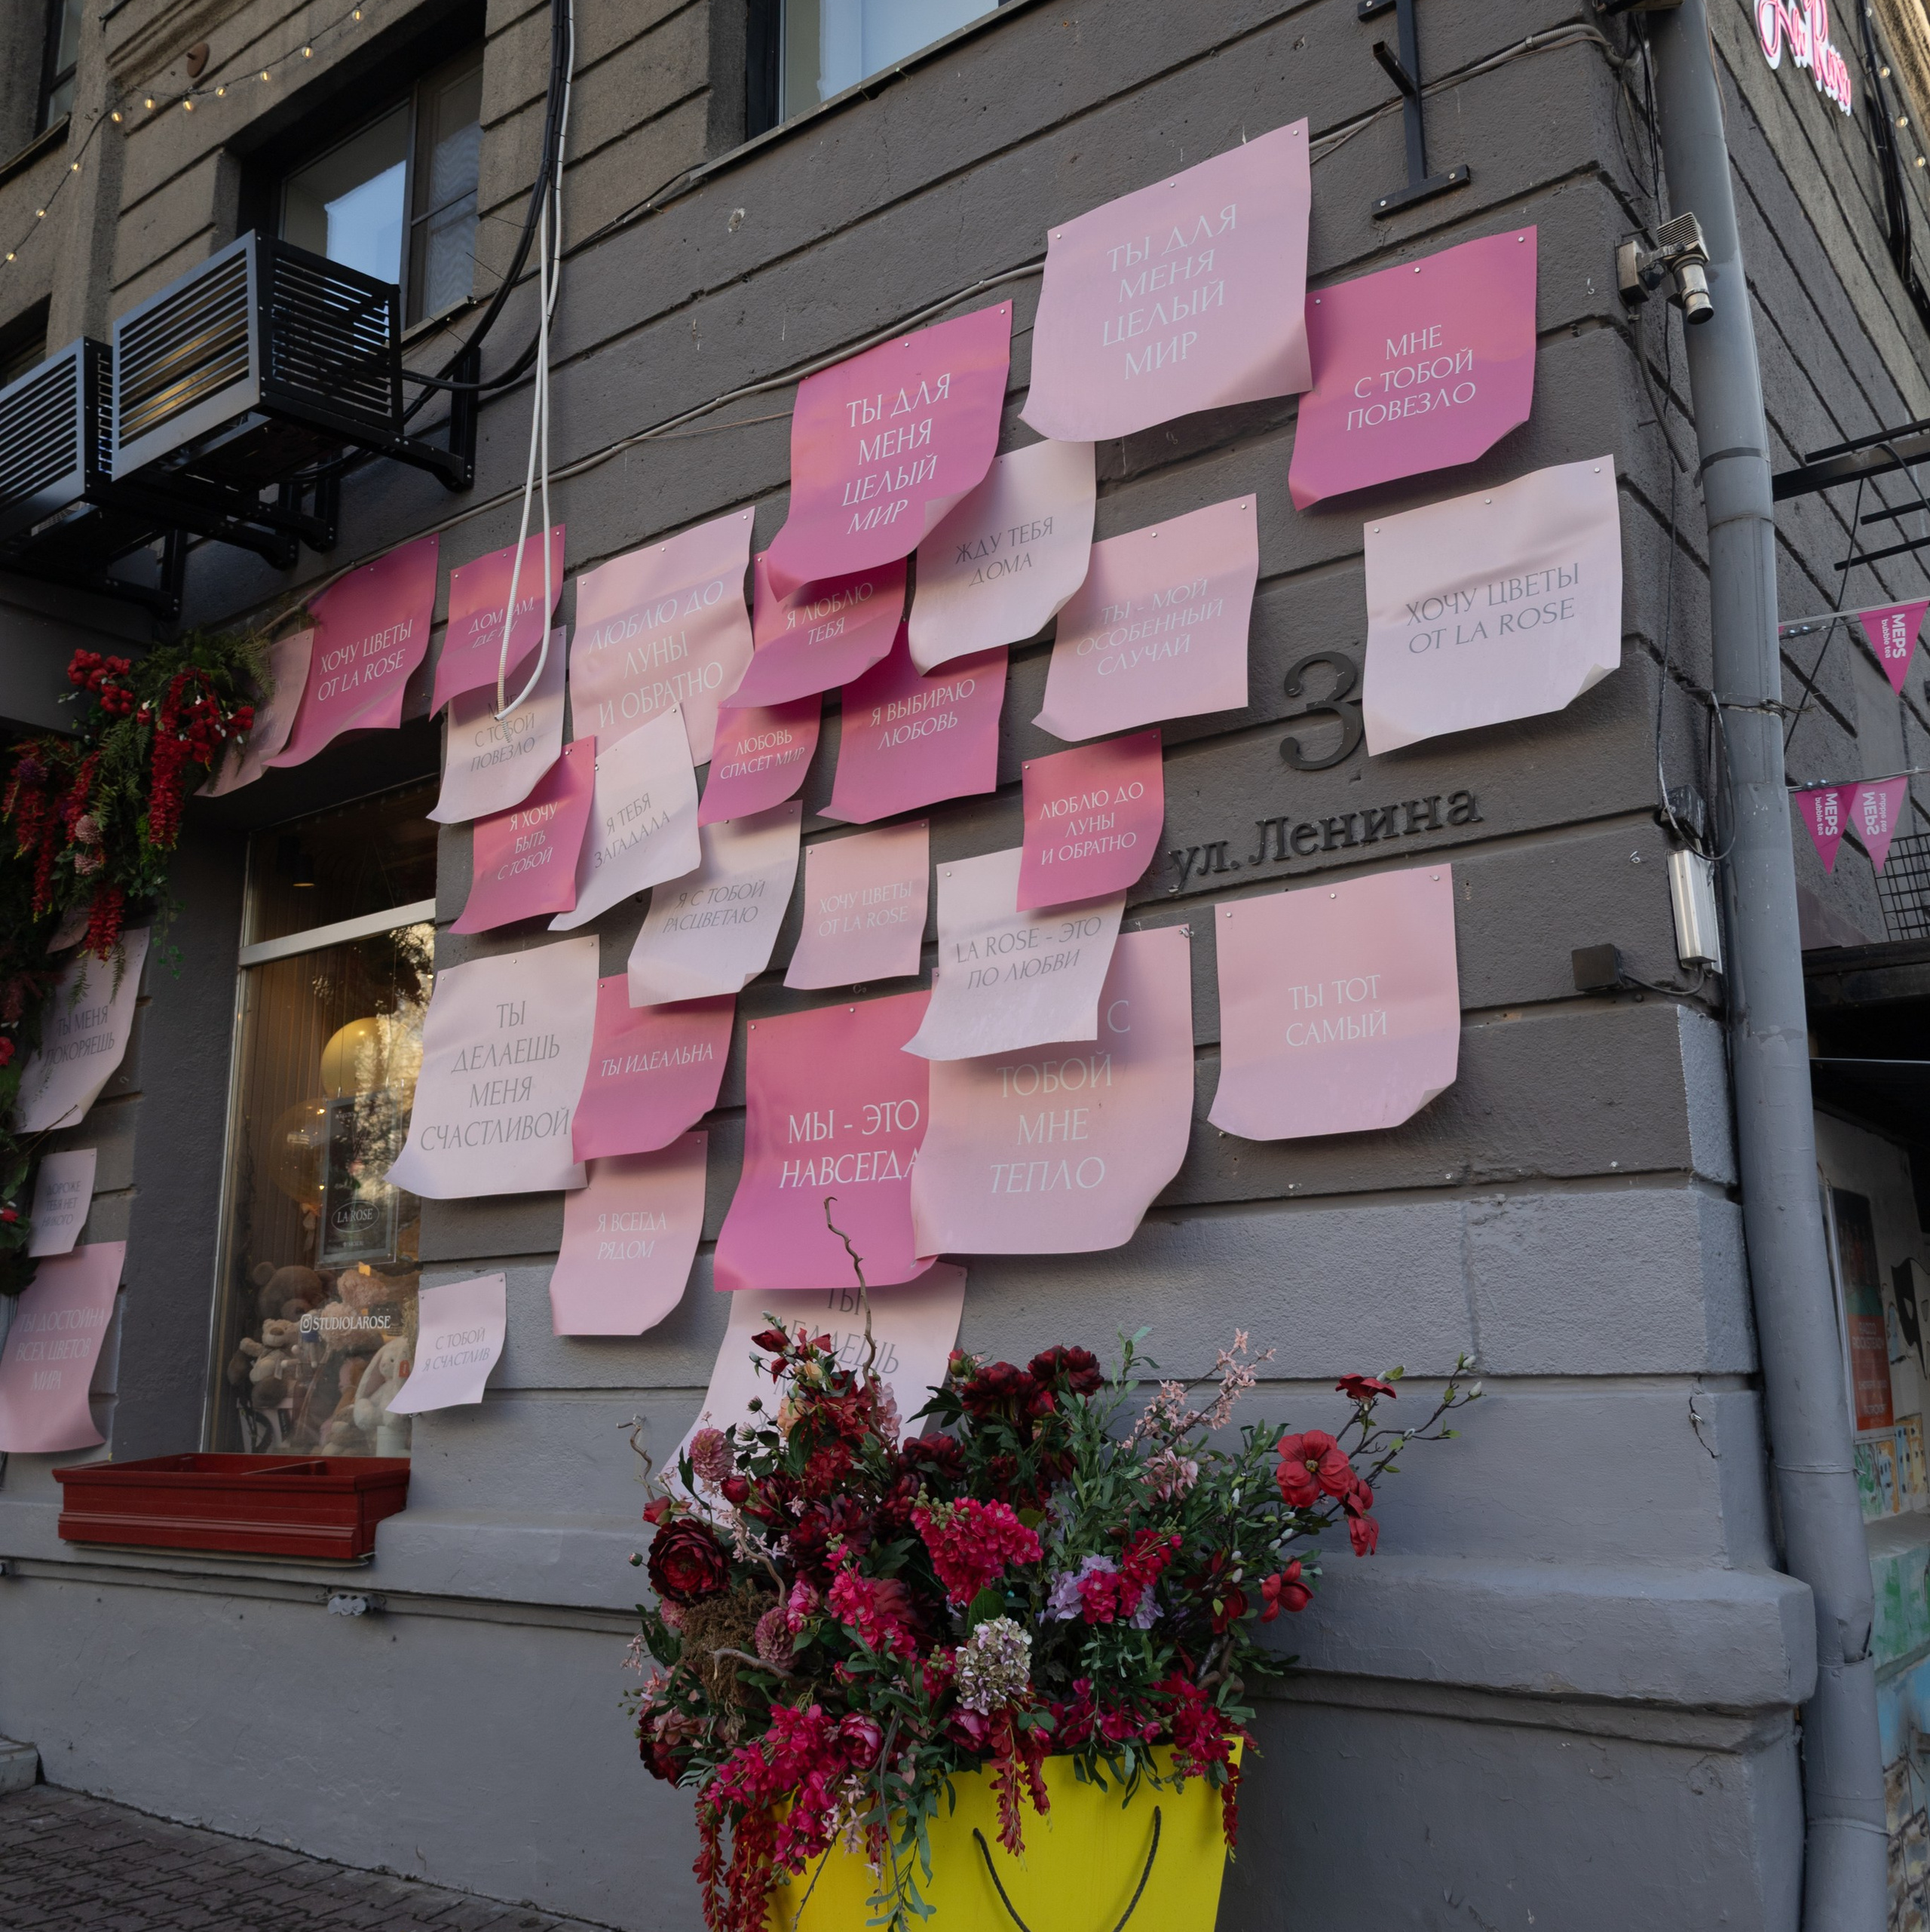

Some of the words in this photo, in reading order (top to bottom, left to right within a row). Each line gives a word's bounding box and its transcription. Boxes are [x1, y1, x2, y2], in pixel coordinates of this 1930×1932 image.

[1107, 237, 1150, 272] ТЫ
[1162, 204, 1239, 251] ДЛЯ
[1118, 248, 1215, 302] МЕНЯ
[1102, 279, 1225, 347] ЦЕЛЫЙ
[1124, 330, 1198, 380] МИР
[1385, 325, 1443, 360] МНЕ
[1354, 377, 1373, 398] С
[1380, 347, 1474, 394] ТОБОЙ
[846, 397, 882, 428] ТЫ
[890, 373, 951, 419] ДЛЯ
[1346, 382, 1476, 431] ПОВЕЗЛО
[857, 418, 933, 465] МЕНЯ
[841, 454, 938, 507] ЦЕЛЫЙ
[846, 499, 908, 535] МИР
[954, 532, 1003, 564] ЖДУ
[1008, 516, 1053, 547] ТЕБЯ
[969, 552, 1033, 588] ДОМА
[786, 609, 798, 630] Я
[802, 581, 873, 623] ЛЮБЛЮ
[1101, 600, 1132, 626] ТЫ
[1152, 578, 1207, 608] МОЙ
[1405, 587, 1477, 627] ХОЧУ
[1487, 562, 1580, 608] ЦВЕТЫ
[468, 608, 503, 635] ДОМ
[510, 596, 535, 616] АМ,
[588, 596, 678, 653] ЛЮБЛЮ
[684, 581, 723, 617] ДО
[807, 617, 845, 646] ТЕБЯ
[1077, 600, 1223, 656] ОСОБЕННЫЙ
[1408, 629, 1447, 654] ОТ
[1455, 618, 1488, 645] LA
[1499, 597, 1576, 636] ROSE
[1881, 618, 1890, 647] bubble
[319, 641, 360, 675] ХОЧУ
[362, 619, 413, 658] ЦВЕТЫ
[623, 630, 688, 679] ЛУНЫ
[1097, 633, 1190, 676] СЛУЧАЙ
[1892, 613, 1907, 659] MEPS
[318, 677, 339, 701] ОТ
[341, 670, 360, 692] LA
[363, 649, 406, 683] ROSE
[599, 701, 615, 728] И
[621, 661, 723, 717] ОБРАТНО
[871, 707, 881, 727] Я
[885, 679, 976, 722] ВЫБИРАЮ
[1280, 650, 1362, 771] 3
[475, 731, 484, 747] С
[735, 729, 792, 756] ЛЮБОВЬ
[878, 712, 959, 750] ЛЮБОВЬ
[471, 738, 535, 771] ПОВЕЗЛО
[774, 747, 805, 767] МИР
[510, 814, 519, 832] Я
[522, 802, 557, 826] ХОЧУ
[605, 818, 614, 836] Я
[617, 793, 651, 823] ТЕБЯ
[1040, 789, 1109, 820] ЛЮБЛЮ
[1114, 782, 1144, 804] ДО
[1815, 796, 1823, 822] bubble
[1824, 792, 1838, 836] MEPS
[515, 830, 546, 854] БЫТЬ
[594, 811, 670, 869] ЗАГАДАЛА
[1065, 812, 1116, 837] ЛУНЫ
[1167, 839, 1239, 893] ул.
[1248, 788, 1484, 865] Ленина
[498, 865, 507, 881] С
[510, 846, 553, 877] ТОБОЙ
[1041, 848, 1054, 866] И
[1058, 832, 1137, 861] ОБРАТНО
[677, 893, 687, 907] Я
[691, 890, 703, 906] С
[707, 880, 766, 904] ТОБОЙ
[819, 894, 858, 915] ХОЧУ
[862, 881, 913, 907] ЦВЕТЫ
[662, 906, 759, 934] РАСЦВЕТАЮ
[819, 920, 840, 937] ОТ
[844, 915, 863, 934] LA
[866, 906, 908, 928] ROSE
[955, 940, 982, 964] LA
[986, 928, 1039, 955] ROSE
[1058, 915, 1102, 943] ЭТО
[967, 968, 999, 990] ПО
[1003, 949, 1080, 984] ЛЮБВИ
[1288, 983, 1324, 1010] ТЫ
[1331, 974, 1381, 1004] ТОТ
[57, 1019, 71, 1036] ТЫ
[75, 1005, 109, 1030] МЕНЯ
[497, 1001, 525, 1029] ТЫ
[1107, 1000, 1131, 1033] С
[1285, 1010, 1388, 1047] САМЫЙ
[44, 1032, 115, 1066] ПОКОРЯЕШЬ
[452, 1035, 561, 1073] ДЕЛАЕШЬ
[601, 1058, 621, 1077] ТЫ
[623, 1041, 714, 1074] ИДЕАЛЬНА
[997, 1048, 1114, 1098] ТОБОЙ
[469, 1075, 532, 1109] МЕНЯ
[420, 1106, 569, 1152] СЧАСТЛИВОЙ
[788, 1109, 834, 1143] МЫ
[861, 1099, 921, 1136] ЭТО
[1017, 1108, 1089, 1145] МНЕ
[46, 1181, 81, 1195] ДОРОЖЕ
[991, 1156, 1105, 1194] ТЕПЛО
[337, 1211, 348, 1222] LA
[350, 1209, 372, 1221] ROSE
[596, 1213, 607, 1232] Я
[611, 1212, 667, 1231] ВСЕГДА
[597, 1240, 655, 1260] РЯДОМ
[19, 1314, 35, 1332] ТЫ
[35, 1305, 104, 1332] ДОСТОЙНА
[313, 1315, 391, 1330] STUDIOLAROSE
[16, 1342, 46, 1362] ВСЕХ
[47, 1338, 91, 1360] ЦВЕТОВ
[435, 1336, 444, 1351] С
[446, 1326, 486, 1347] ТОБОЙ
[423, 1358, 430, 1372] Я
[433, 1345, 490, 1369] СЧАСТЛИВ
[31, 1370, 61, 1390] МИРА
